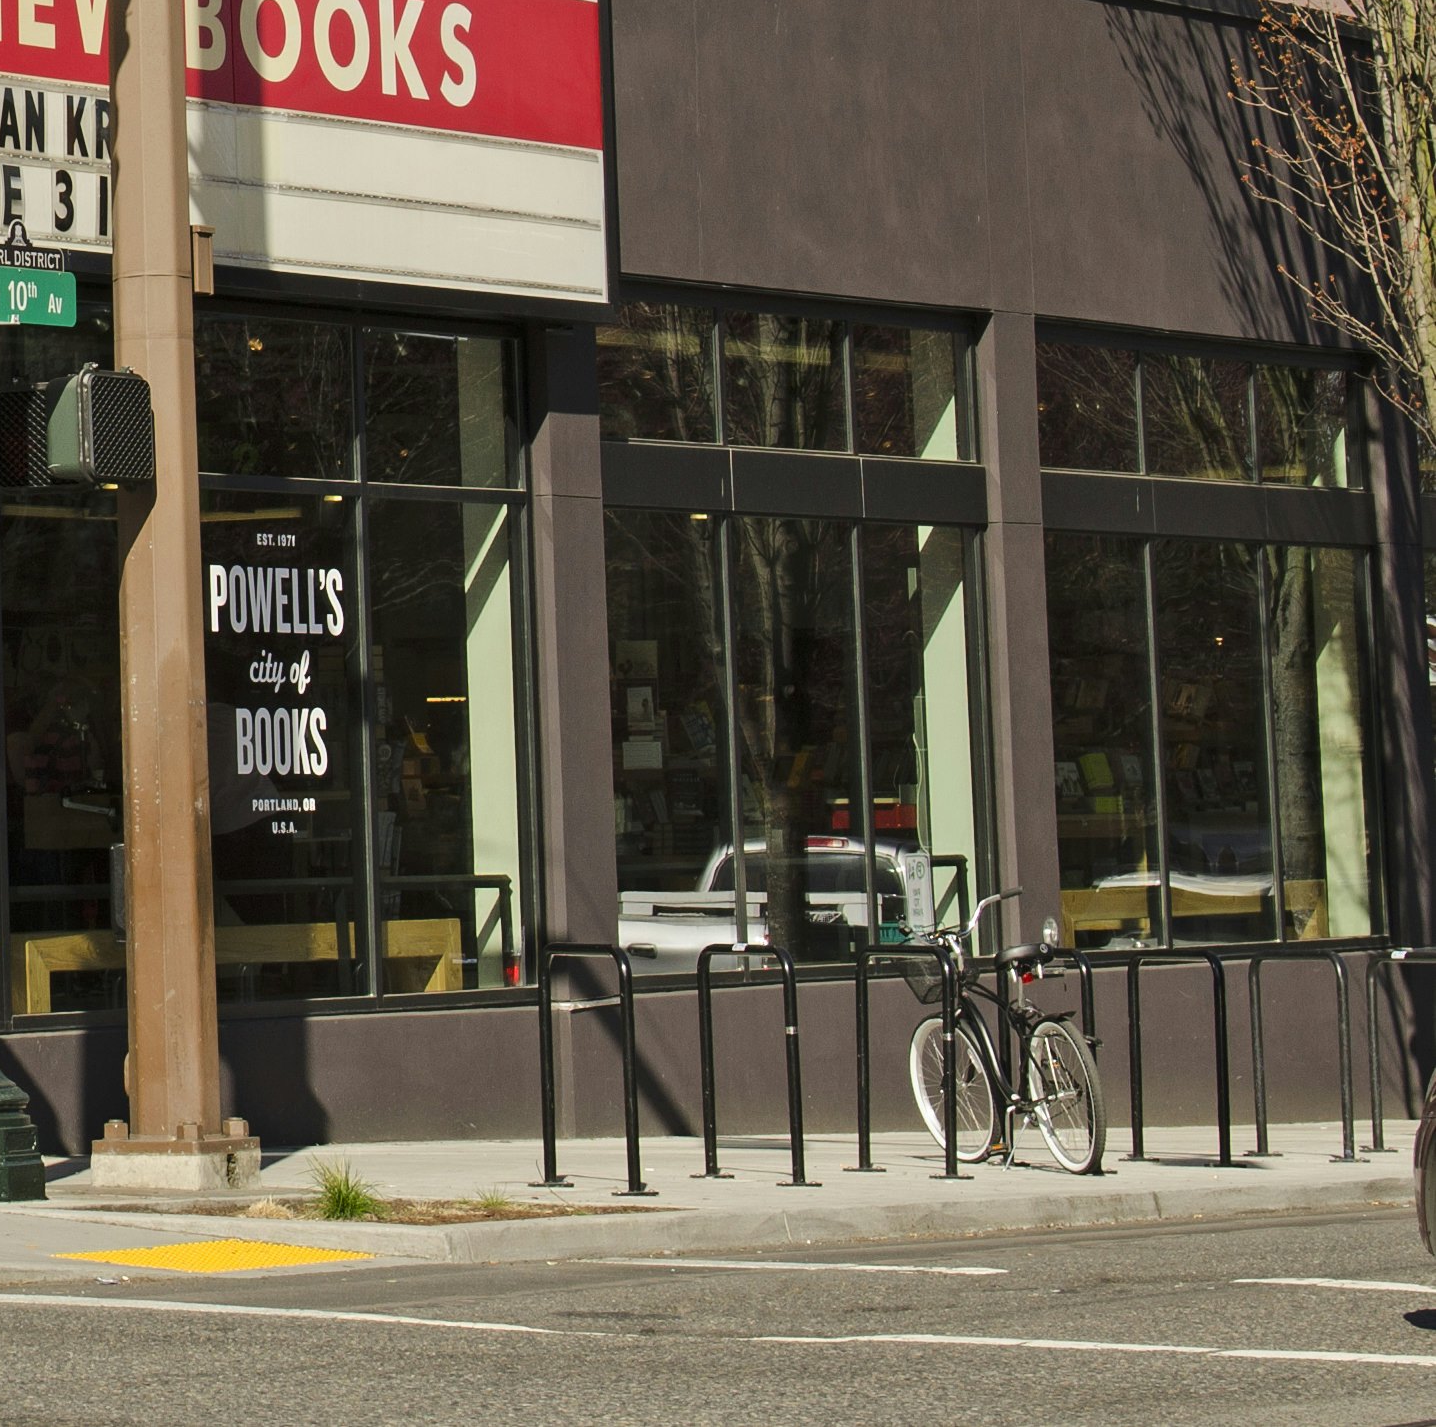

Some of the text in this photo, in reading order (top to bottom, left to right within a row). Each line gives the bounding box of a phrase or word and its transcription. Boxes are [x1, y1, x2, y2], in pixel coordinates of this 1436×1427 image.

[13, 248, 61, 270] DISTRICT
[7, 279, 38, 312] 10th
[47, 293, 64, 315] Av
[256, 533, 296, 547] EST. 1971
[209, 564, 344, 637] POWELL'S
[249, 649, 311, 695] city of
[235, 707, 328, 776] BOOKS
[252, 797, 316, 813] PORTLAND, OR
[272, 822, 298, 834] U.S.A.
